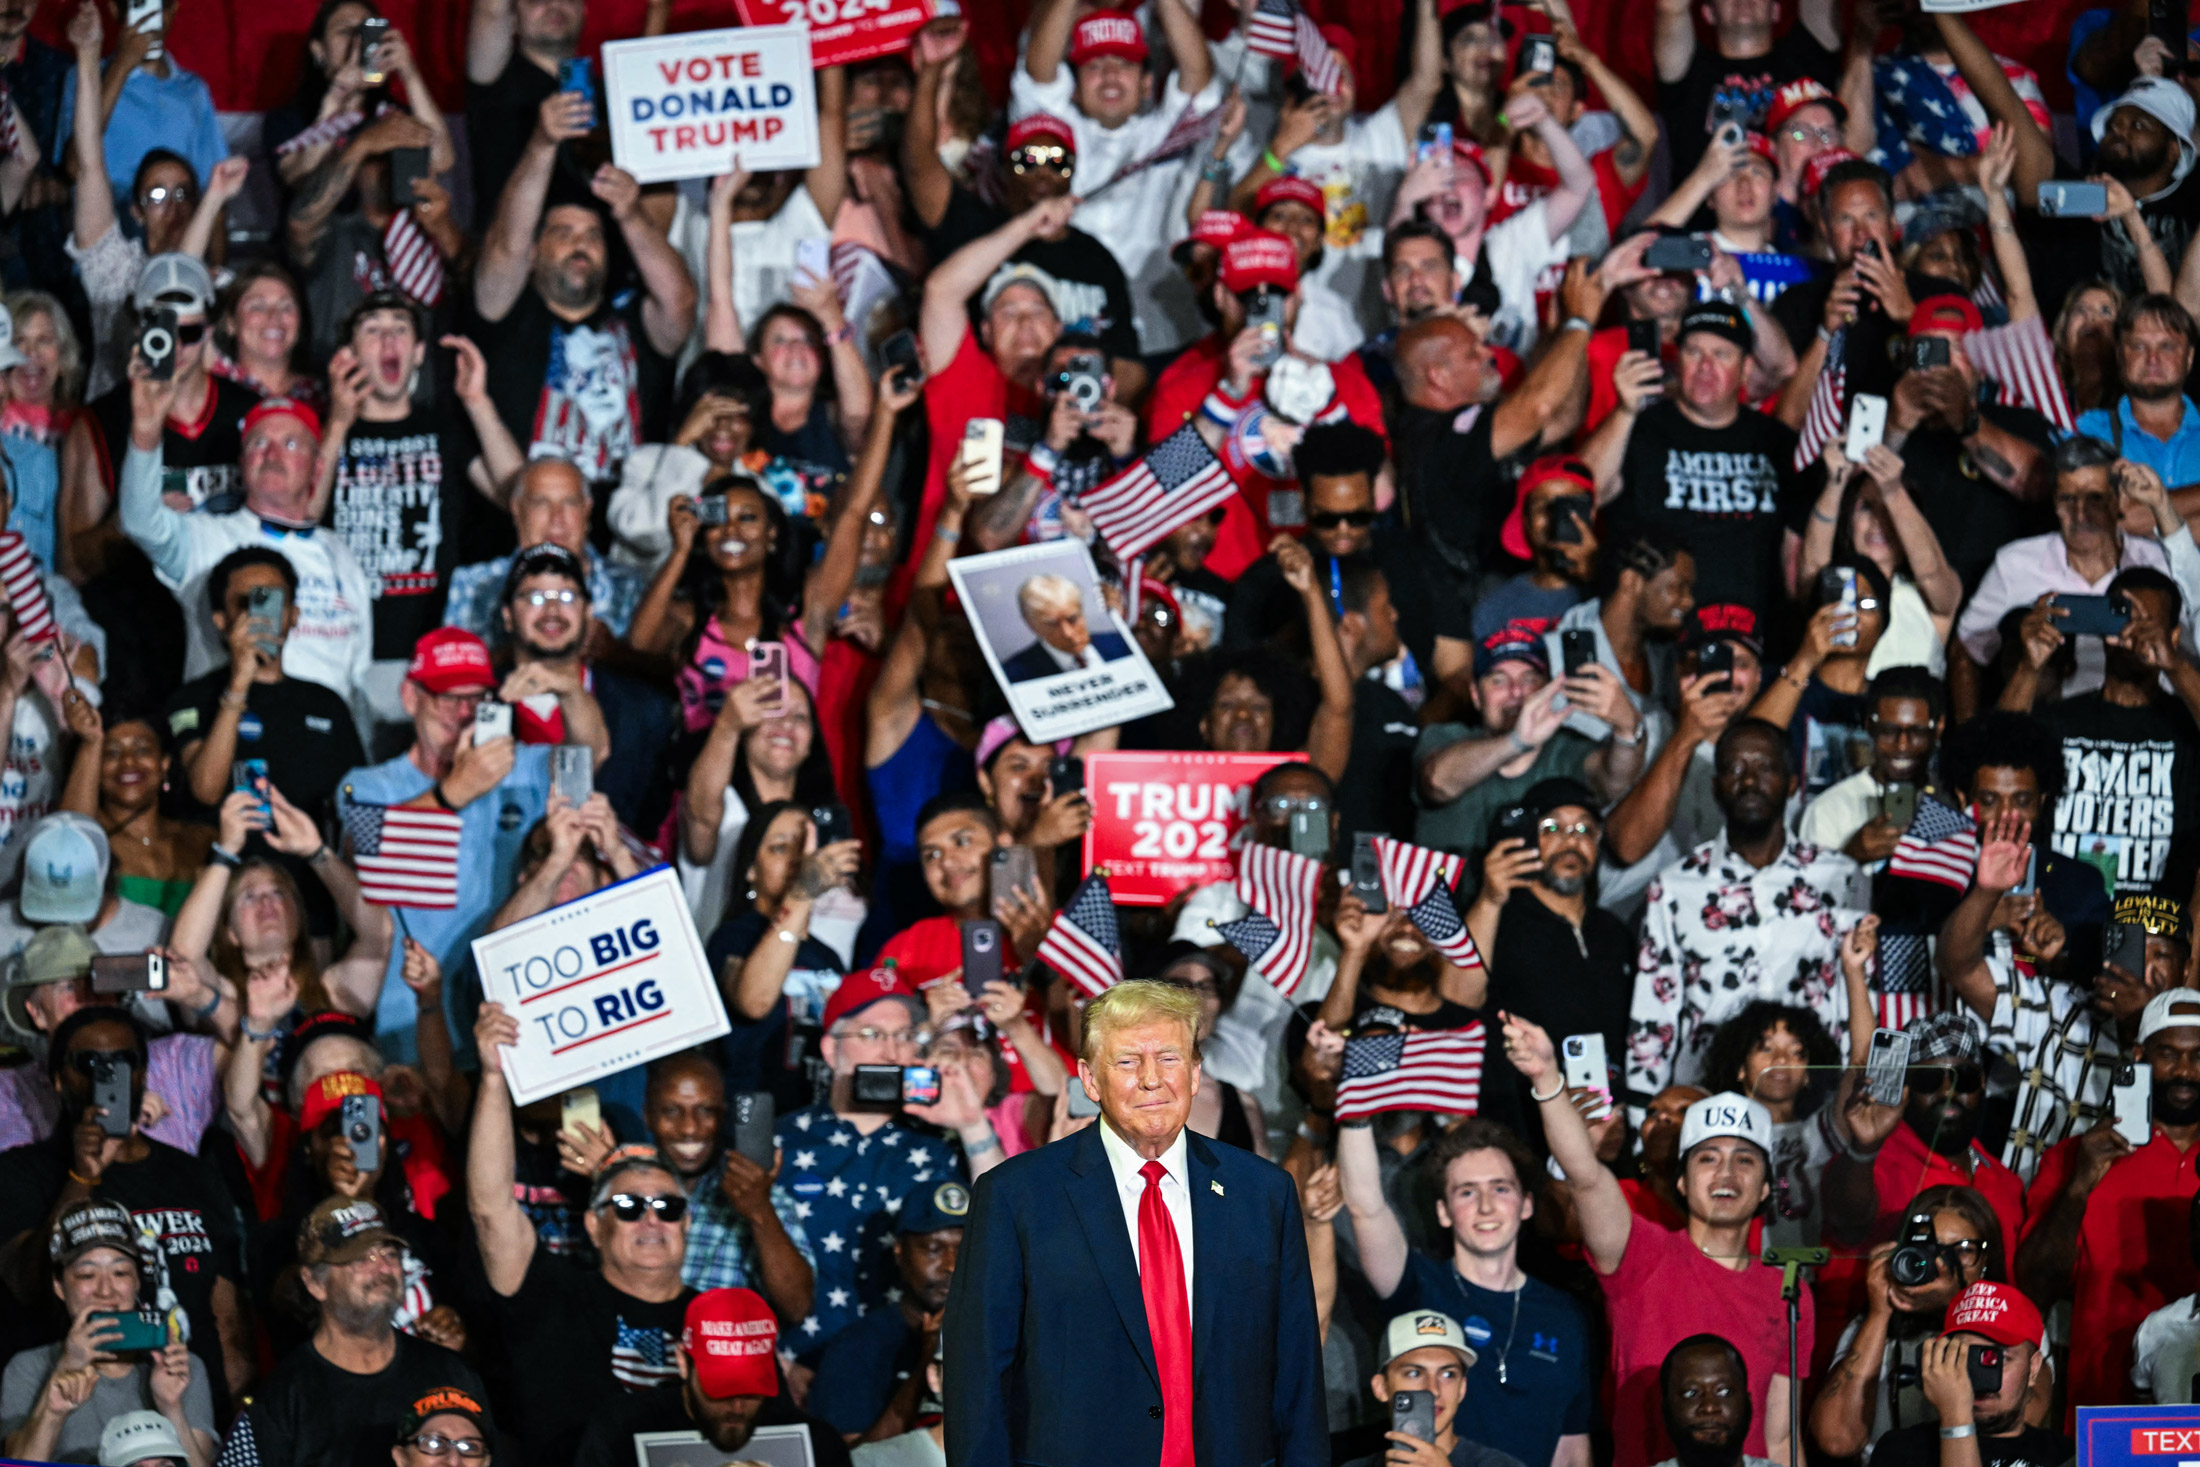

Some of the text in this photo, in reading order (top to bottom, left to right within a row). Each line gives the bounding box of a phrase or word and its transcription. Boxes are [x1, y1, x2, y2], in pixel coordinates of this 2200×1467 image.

[659, 53, 763, 85] VOTE
[631, 84, 794, 122] DONALD
[648, 116, 785, 154] TRUMP
[1664, 448, 1778, 478] AMERICA
[1664, 475, 1779, 513] FIRST
[1030, 681, 1148, 719] SURRENDER
[1047, 674, 1114, 698] NEVER
[1107, 781, 1253, 822] TRUM
[2054, 791, 2174, 838] VOTERS
[2115, 894, 2180, 915] LOYALTY
[504, 918, 661, 998] TOO BIG
[533, 979, 665, 1046] TO RIG
[1705, 1106, 1753, 1131] USA
[1964, 1282, 1997, 1299] KEEP
[1952, 1296, 2008, 1317] AMERICA
[1956, 1309, 1999, 1326] GREAT
[706, 1339, 743, 1356] GREAT
[115, 1422, 163, 1439] TRUMP
